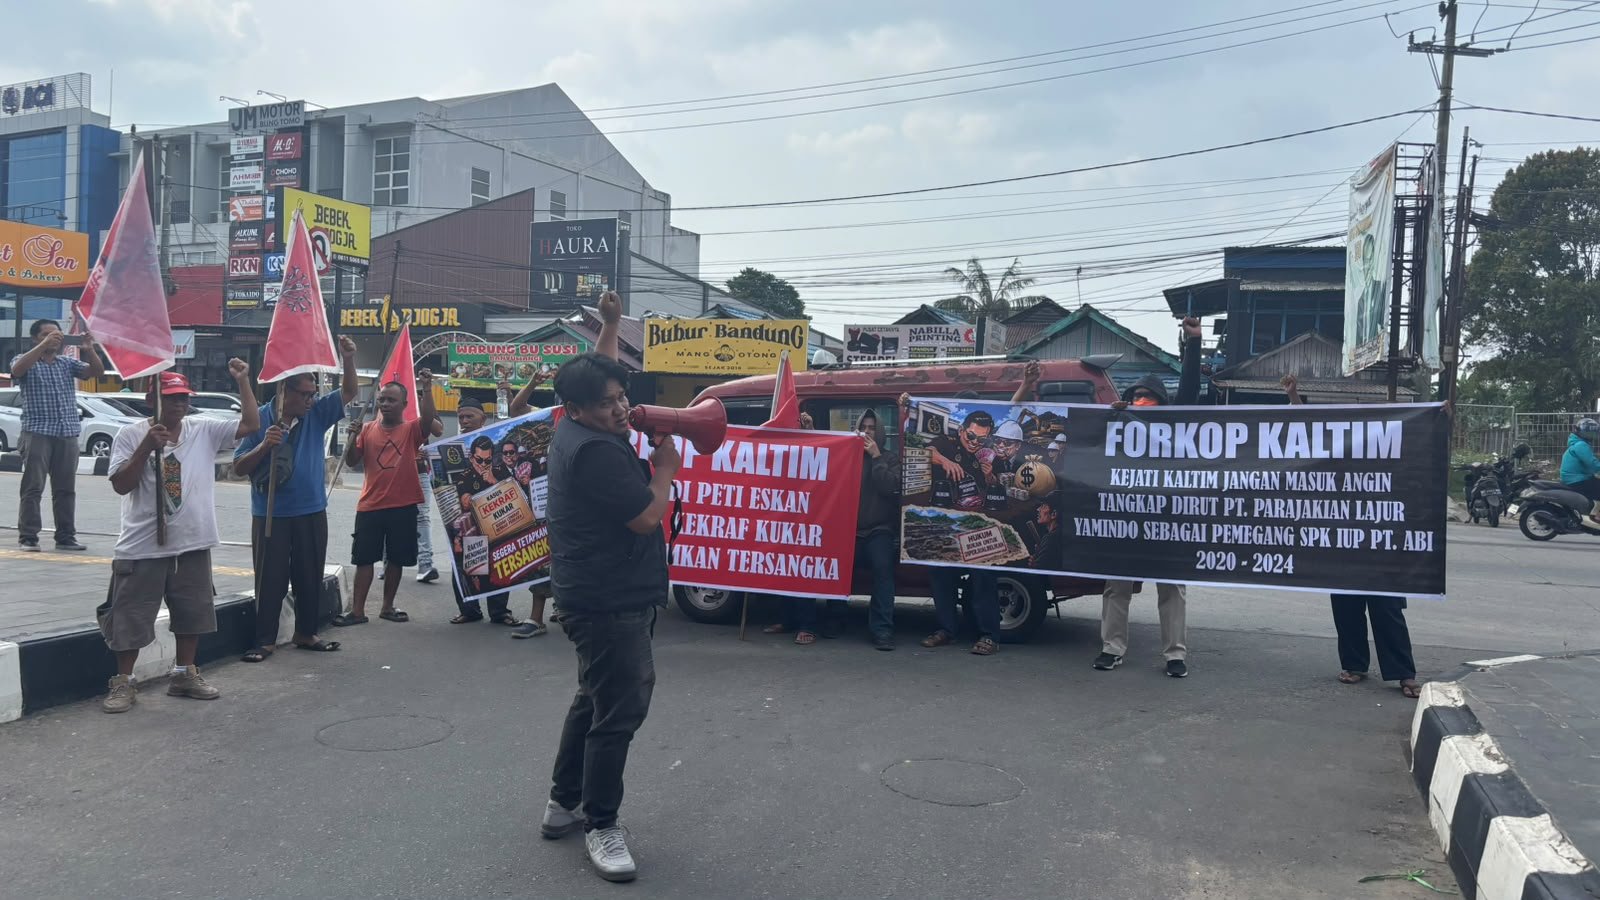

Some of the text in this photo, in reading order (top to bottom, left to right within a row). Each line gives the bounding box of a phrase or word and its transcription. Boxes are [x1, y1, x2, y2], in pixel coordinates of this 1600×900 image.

[231, 102, 300, 131] JM MOTOR
[313, 203, 352, 230] BEBEK
[23, 234, 77, 270] Sen
[329, 228, 357, 251] OGJA
[540, 236, 610, 256] HAURA
[7, 267, 64, 281] & Bakers
[231, 258, 258, 274] RKN
[340, 308, 381, 327] BEBEK
[648, 322, 708, 347] Bubur
[908, 335, 962, 343] PRINTING
[909, 326, 960, 337] NABILLA
[456, 344, 516, 355] WARUNG
[519, 344, 539, 355] BU
[543, 344, 578, 356] SUSI
[1105, 420, 1402, 459] FORKOP KALTIM
[711, 439, 829, 482] KALTIM
[1110, 468, 1392, 493] KEJATI KALTIM JANGAN MASUK ANGIN
[482, 490, 515, 515] KEKRAF
[486, 489, 502, 501] KASUS
[696, 481, 743, 508] PETI
[749, 486, 811, 514] ESKAN
[492, 502, 514, 521] KUKAR
[1098, 492, 1405, 524] TANGKAP DIRUT PT. PARAJAKIAN LAJUR
[492, 525, 549, 561] SEGERA TETAPKAN
[755, 519, 822, 547] KUKAR
[968, 530, 993, 543] HUKUM
[1074, 517, 1434, 552] YAMINDO SEBAGAI PEMEGANG SPK IUP PT. ABI
[493, 537, 551, 579] TERSANGK
[666, 542, 840, 581] MKAN TERSANGKA
[1195, 550, 1237, 572] 2020
[1252, 553, 1294, 574] 2024
